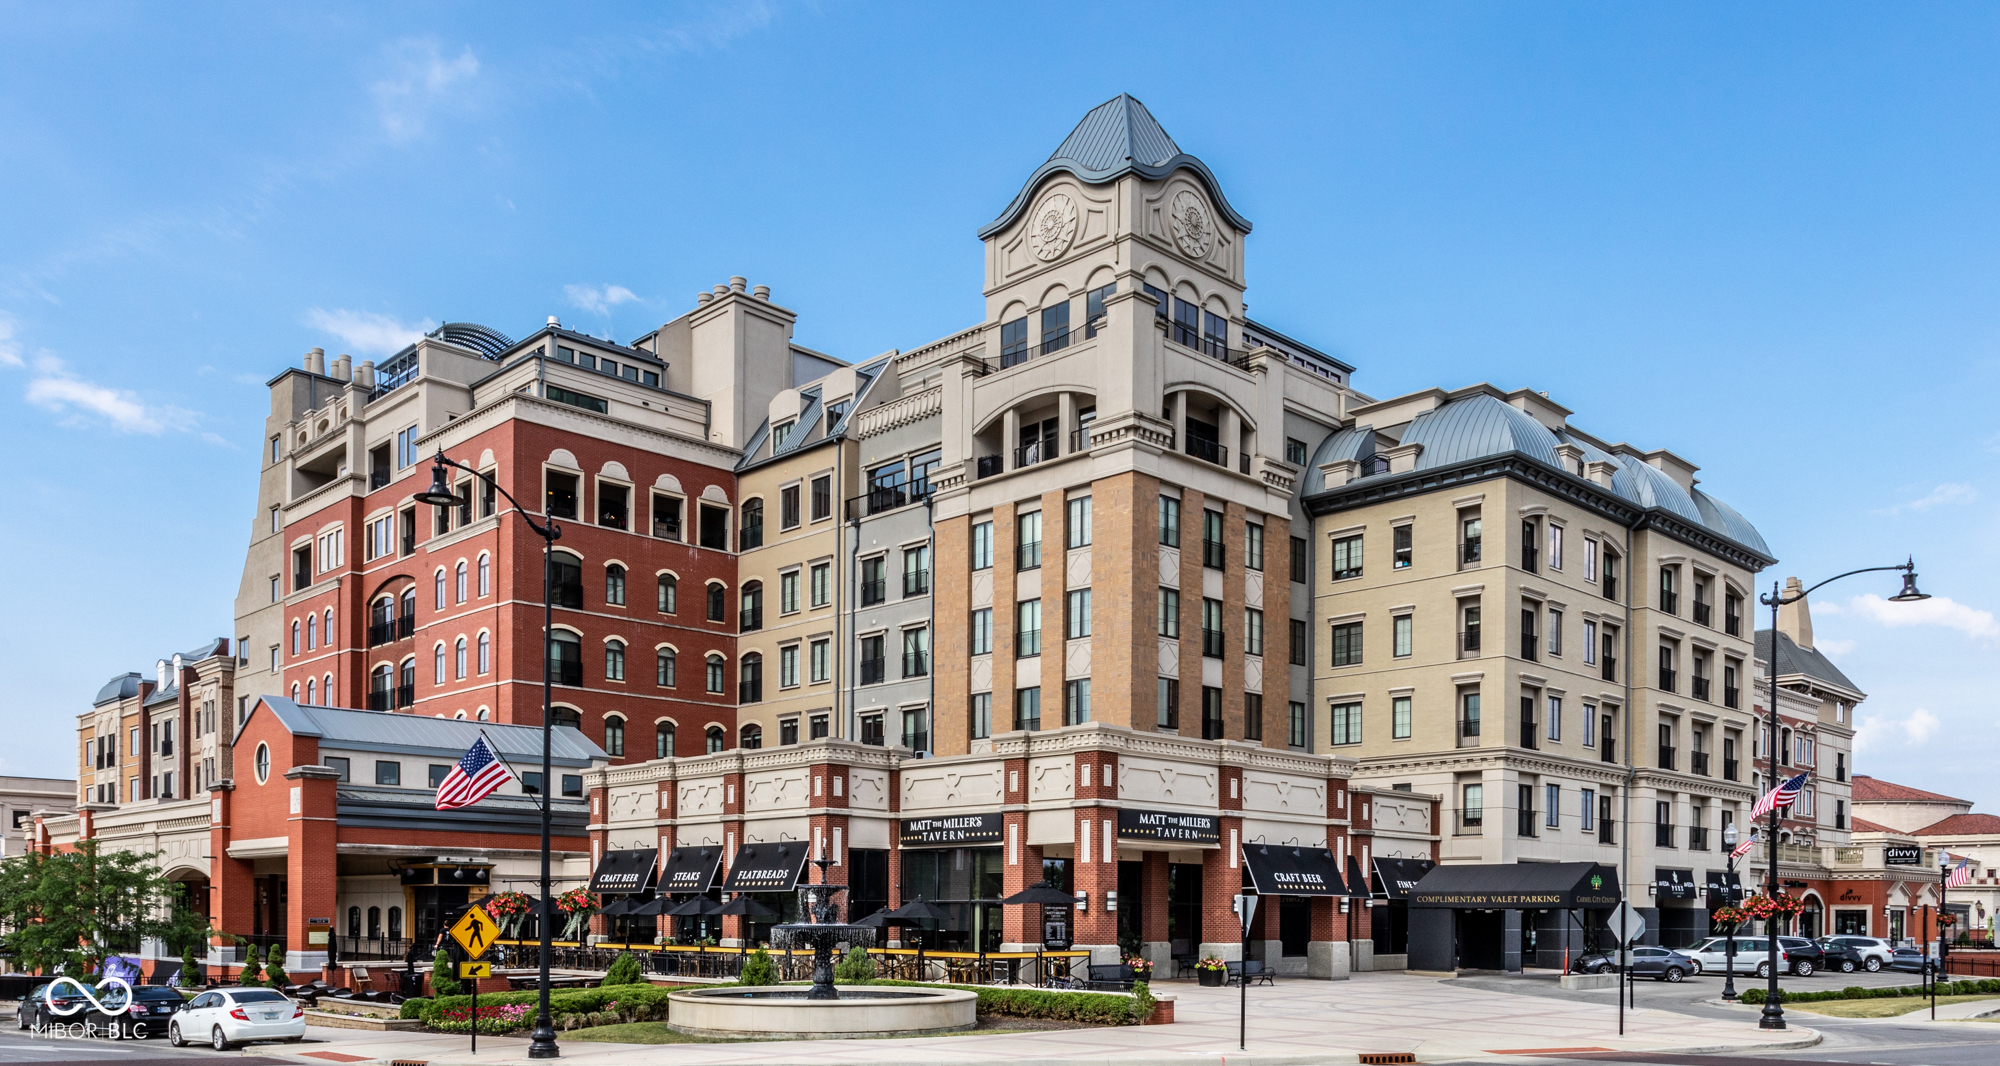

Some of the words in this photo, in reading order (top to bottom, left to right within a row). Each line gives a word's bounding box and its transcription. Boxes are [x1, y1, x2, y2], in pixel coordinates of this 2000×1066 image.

[910, 820, 932, 831] MATT
[932, 820, 942, 828] THE
[943, 816, 982, 829] MILLER'S
[1139, 813, 1167, 825] MATT
[1179, 816, 1211, 829] MILLER'S
[922, 830, 965, 841] TAVERN
[1156, 827, 1198, 839] TAVERN
[1888, 848, 1918, 859] divvy
[600, 873, 622, 883] CRAFT
[622, 873, 639, 882] BEER
[672, 871, 701, 881] STEAKS
[737, 869, 789, 880] FLATBREADS
[1274, 872, 1300, 883] CRAFT
[1302, 873, 1324, 883] BEER
[1396, 880, 1413, 889] FINE
[1416, 895, 1487, 903] COMPLIMENTARY
[1490, 895, 1518, 903] VALET
[1520, 894, 1560, 903] PARKING
[1839, 893, 1862, 902] divvy
